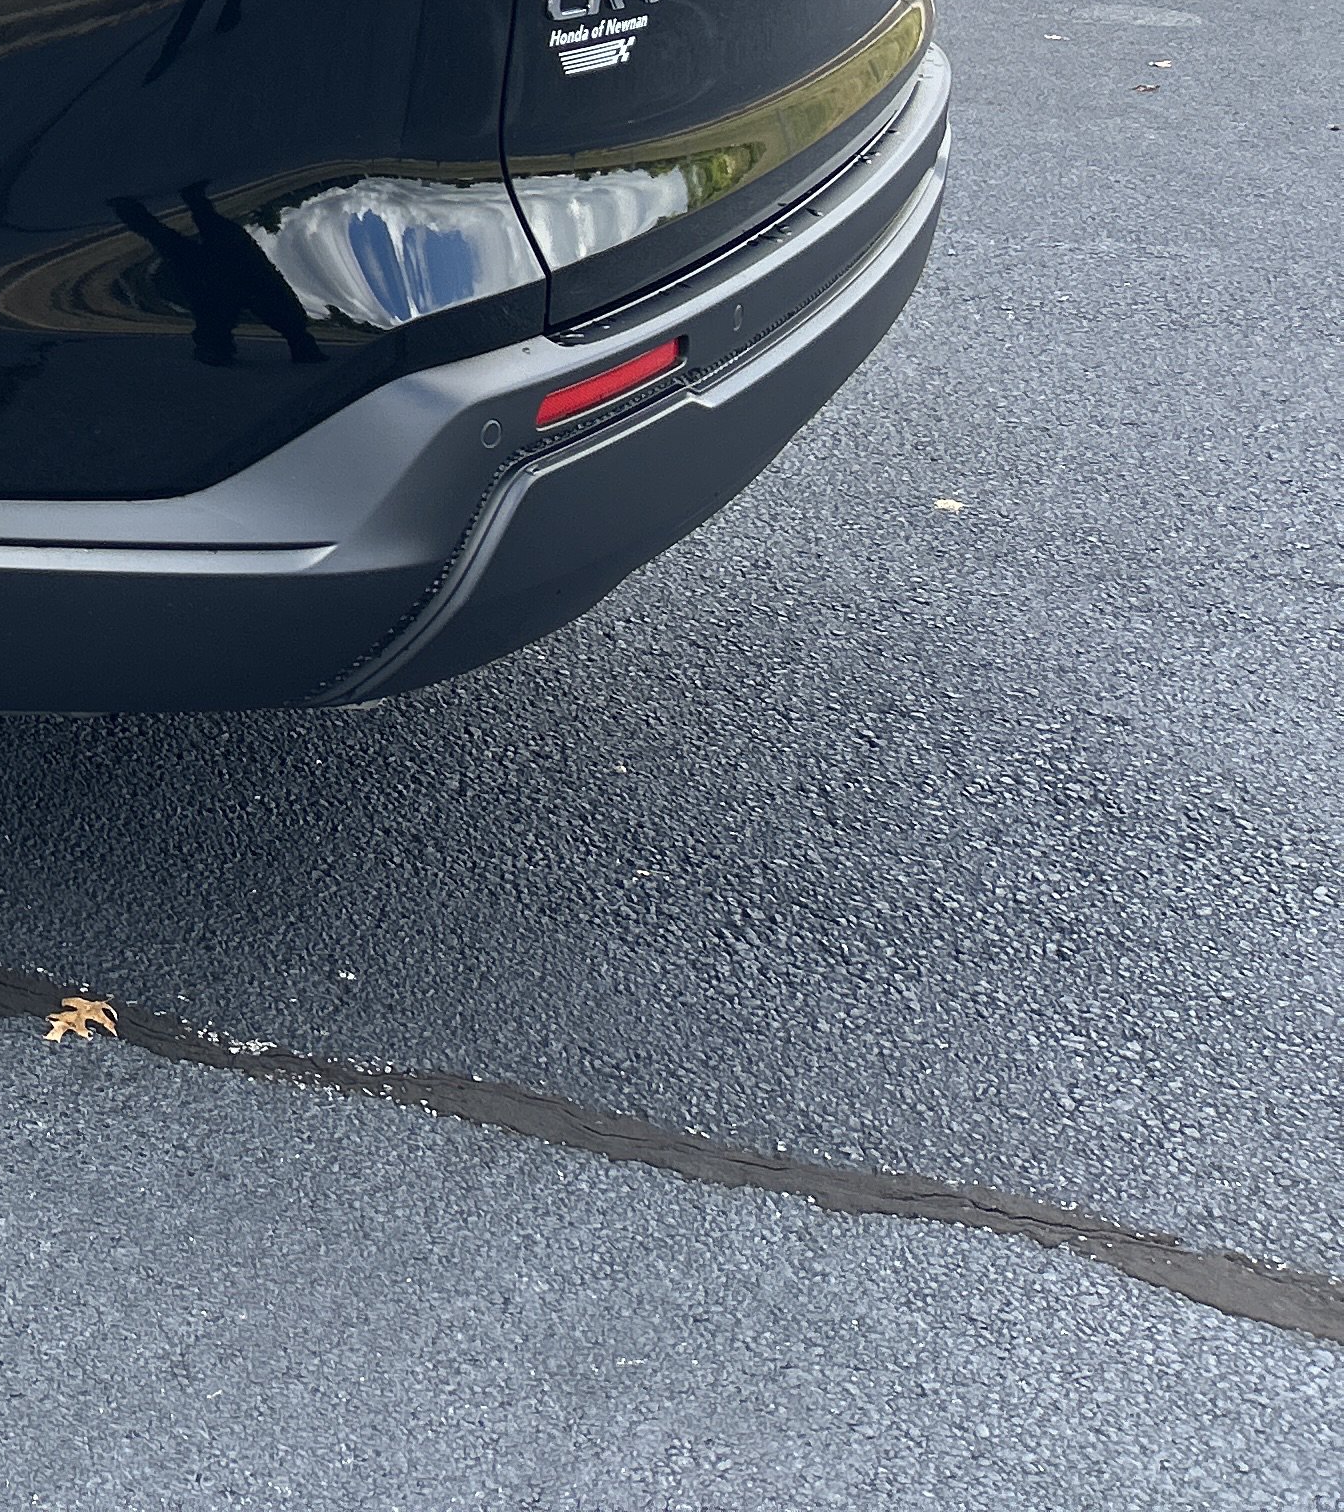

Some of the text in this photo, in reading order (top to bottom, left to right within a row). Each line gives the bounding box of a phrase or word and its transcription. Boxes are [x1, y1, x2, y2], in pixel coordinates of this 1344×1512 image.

[549, 15, 648, 47] Honda of Newnan
